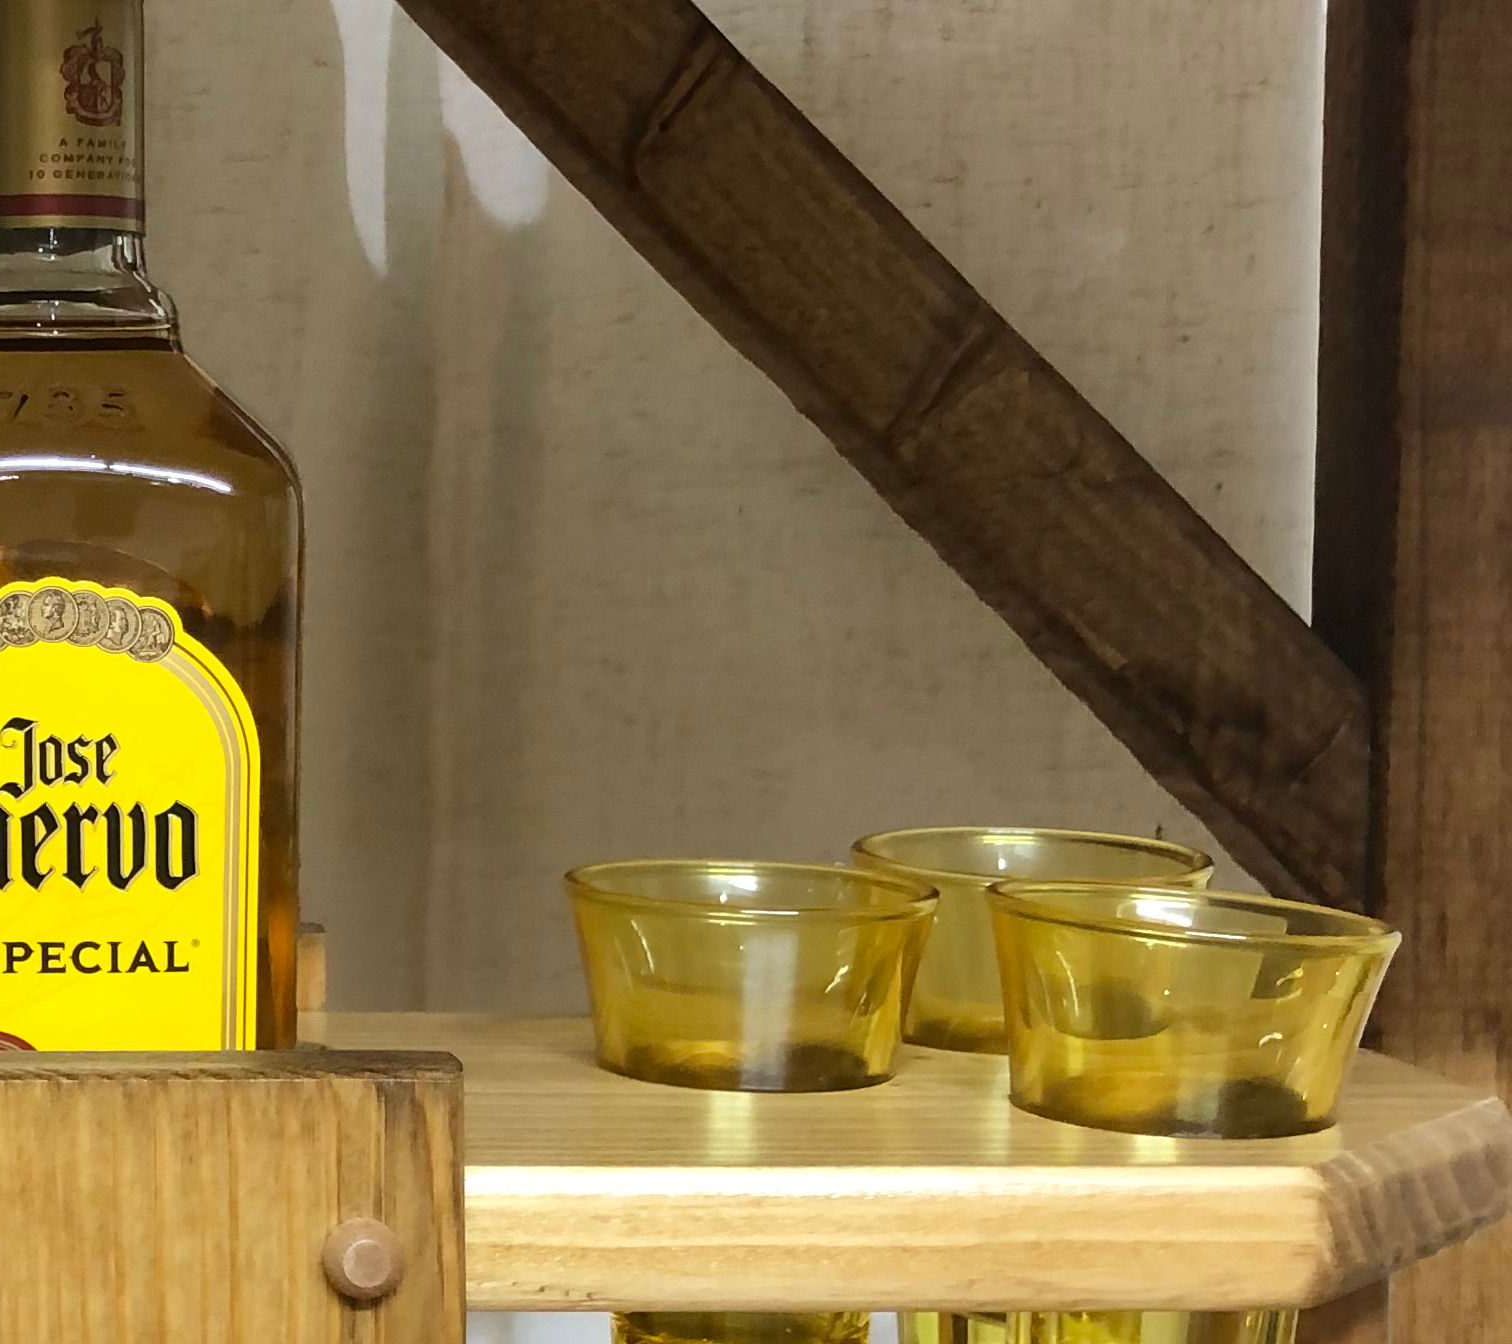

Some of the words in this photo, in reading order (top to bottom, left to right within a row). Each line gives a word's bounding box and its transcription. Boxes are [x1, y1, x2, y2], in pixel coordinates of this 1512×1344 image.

[59, 138, 68, 147] A
[77, 138, 127, 150] FAMILY
[39, 154, 114, 165] COMPANY
[29, 169, 46, 180] 10
